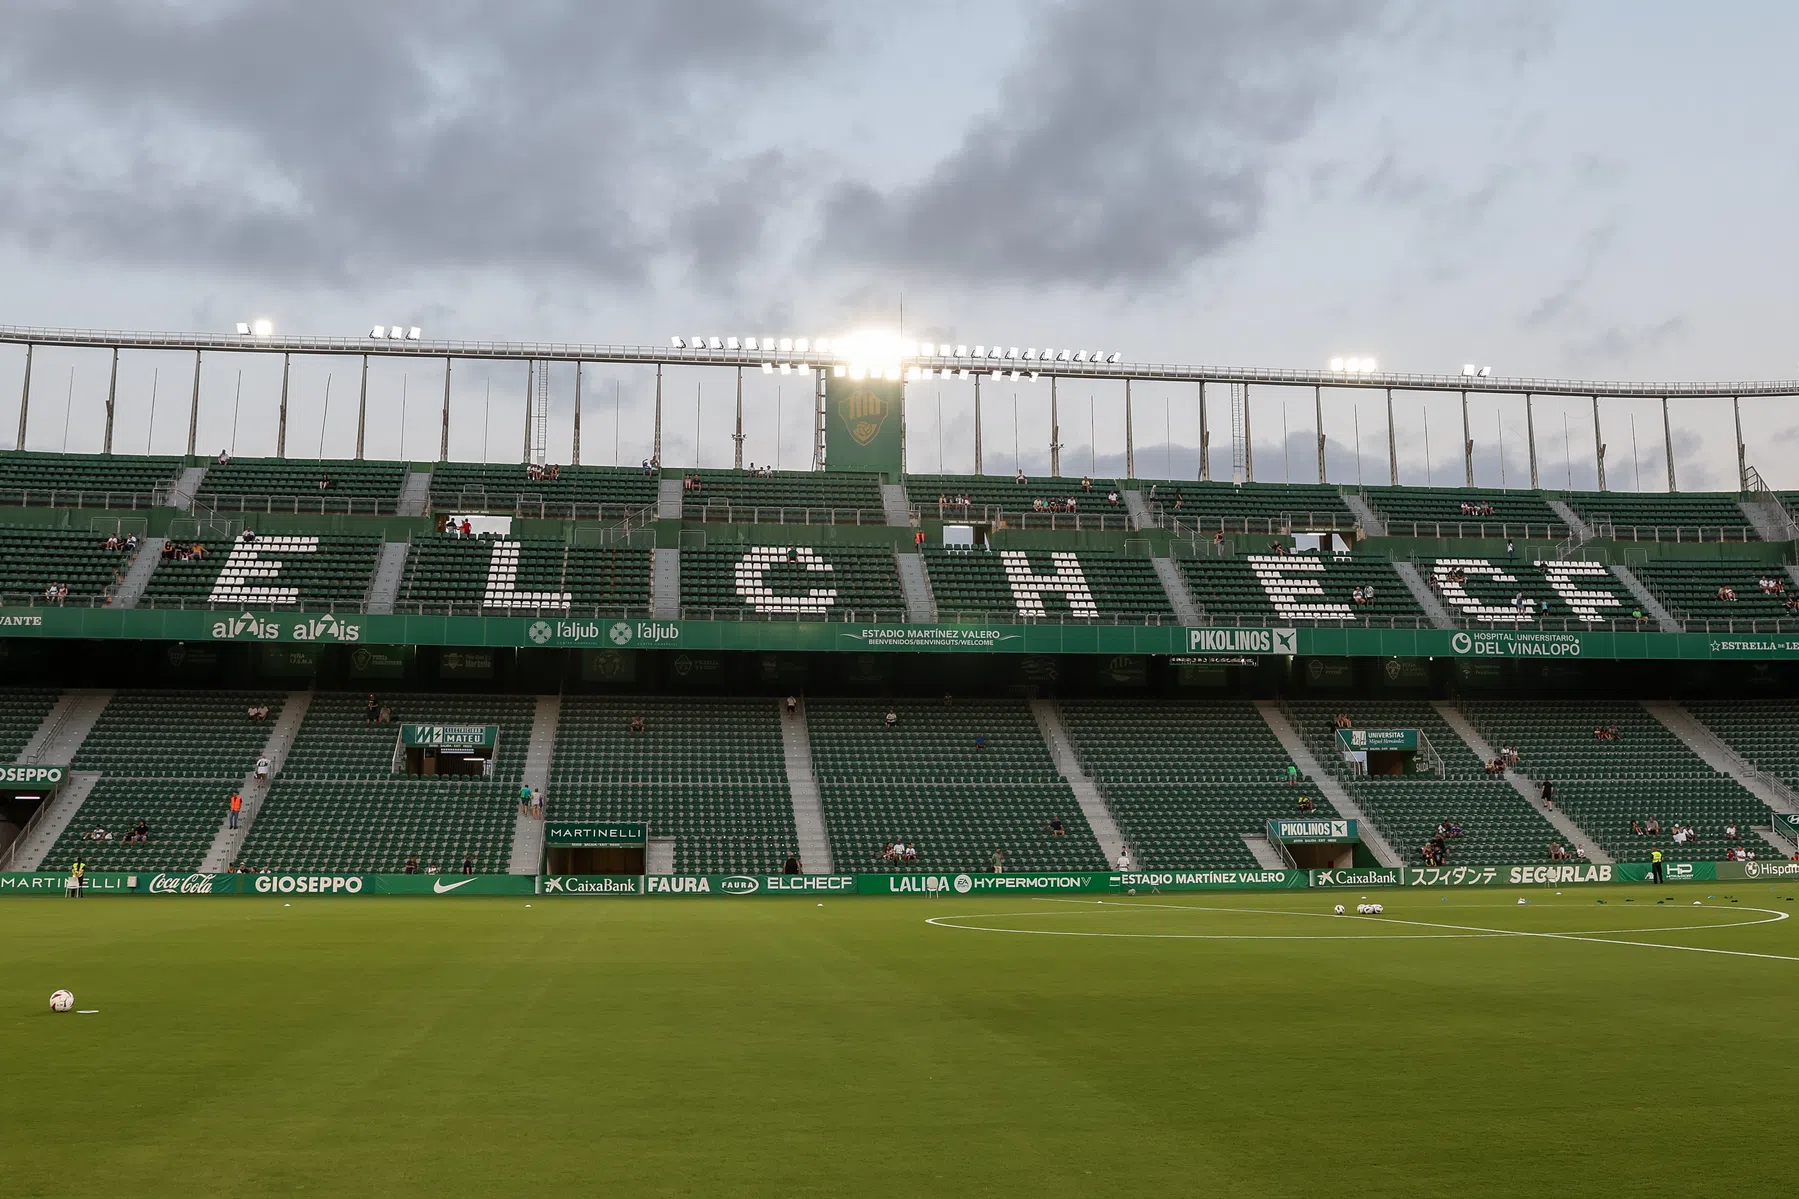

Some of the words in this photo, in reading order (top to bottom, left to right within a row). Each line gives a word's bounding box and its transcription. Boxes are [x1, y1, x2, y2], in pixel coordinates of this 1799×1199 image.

[862, 630, 905, 638] ESTADIO
[907, 628, 959, 639] MARTÍNEZ
[961, 630, 1000, 639] VALERO
[1190, 630, 1270, 650] PIKOLINOS
[1474, 632, 1514, 640] HOSPITAL
[1475, 642, 1504, 654] DEL
[1722, 642, 1777, 650] ESTRELLA
[1786, 642, 1799, 650] LE
[550, 829, 641, 838] MARTINELLI
[1281, 822, 1330, 836] PIKOLINOS
[1122, 872, 1173, 884] ESTADIO
[1176, 870, 1236, 884] MARTÍNEZ
[1239, 872, 1285, 883] VALERO
[1336, 870, 1397, 884] CaixaBank
[1412, 866, 1497, 886] スフィダンテ
[254, 876, 363, 892] GIOSEPPO
[565, 878, 636, 892] CaixaBank
[648, 877, 710, 892] FAURA
[721, 881, 754, 889] FAURA
